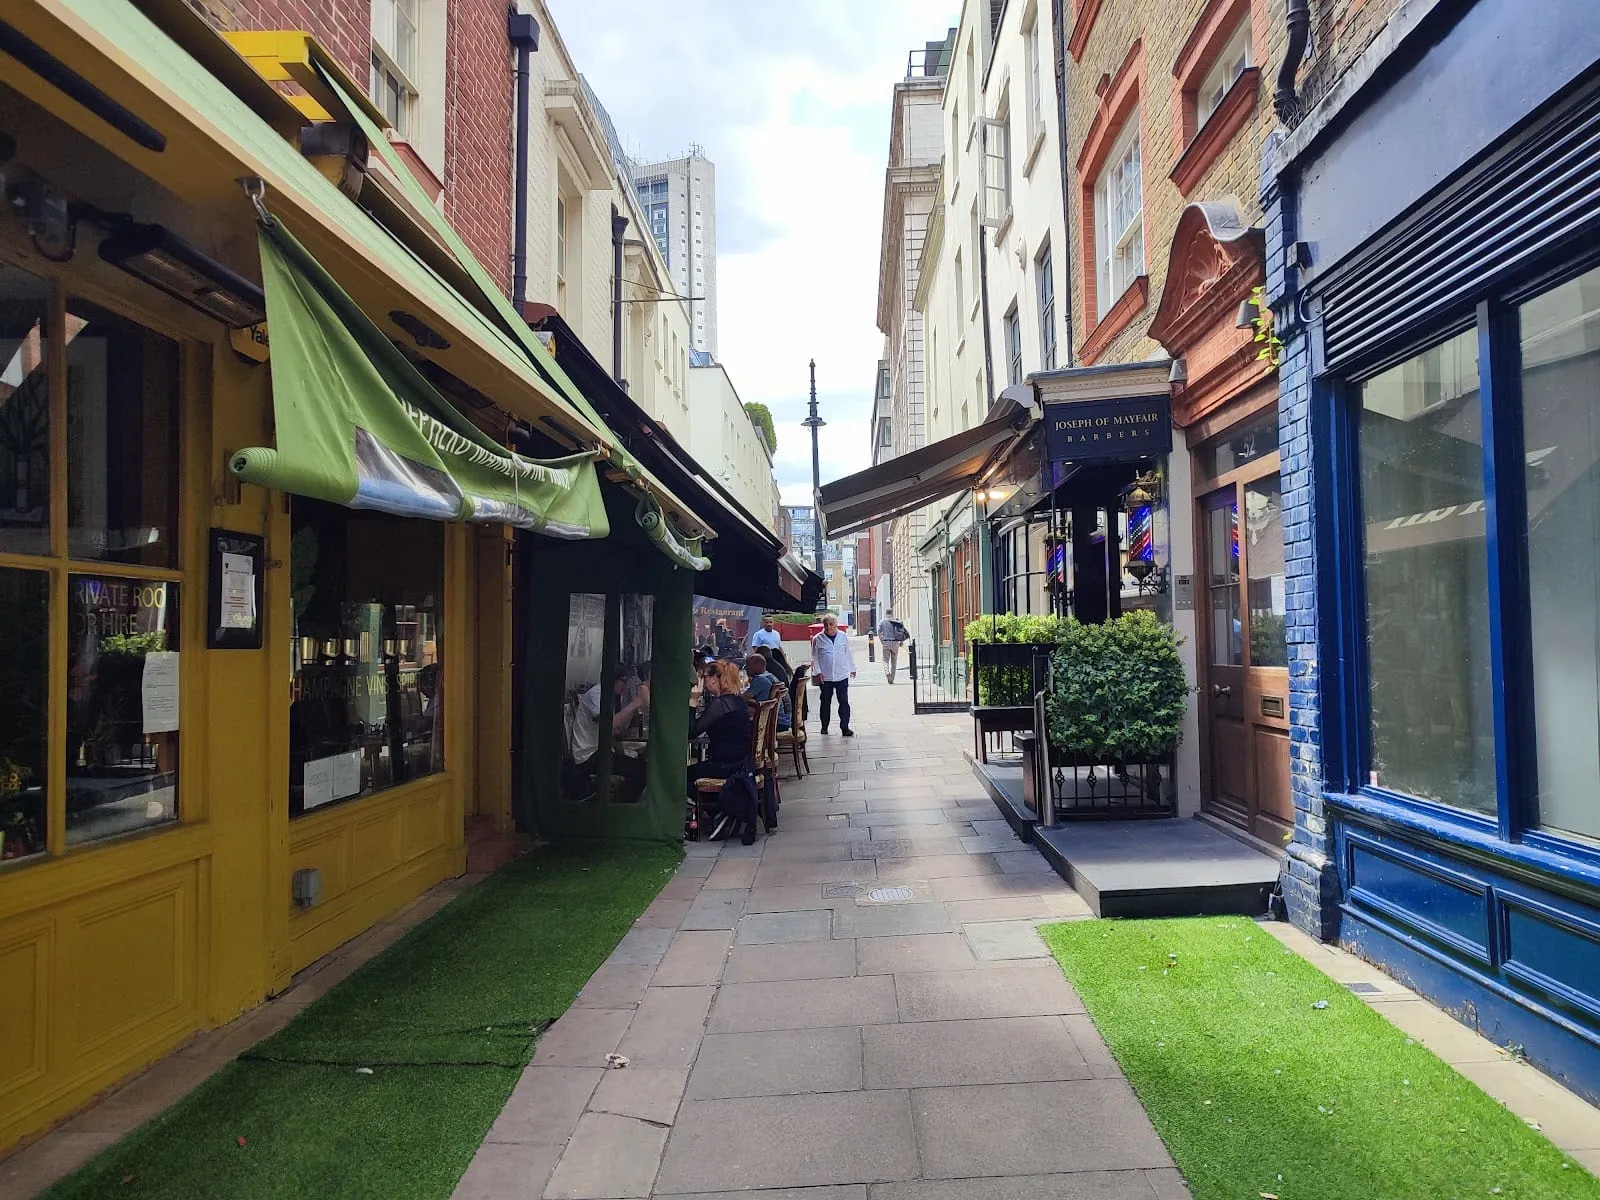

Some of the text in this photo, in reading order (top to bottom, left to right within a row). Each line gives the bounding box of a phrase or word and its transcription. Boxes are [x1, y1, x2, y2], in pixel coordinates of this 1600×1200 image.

[1055, 412, 1159, 431] JOSEPH OF MAYFAIR
[1067, 429, 1150, 443] BARBERS
[700, 606, 745, 617] Restaurant
[102, 613, 138, 635] HIRE
[366, 673, 390, 697] VINS
